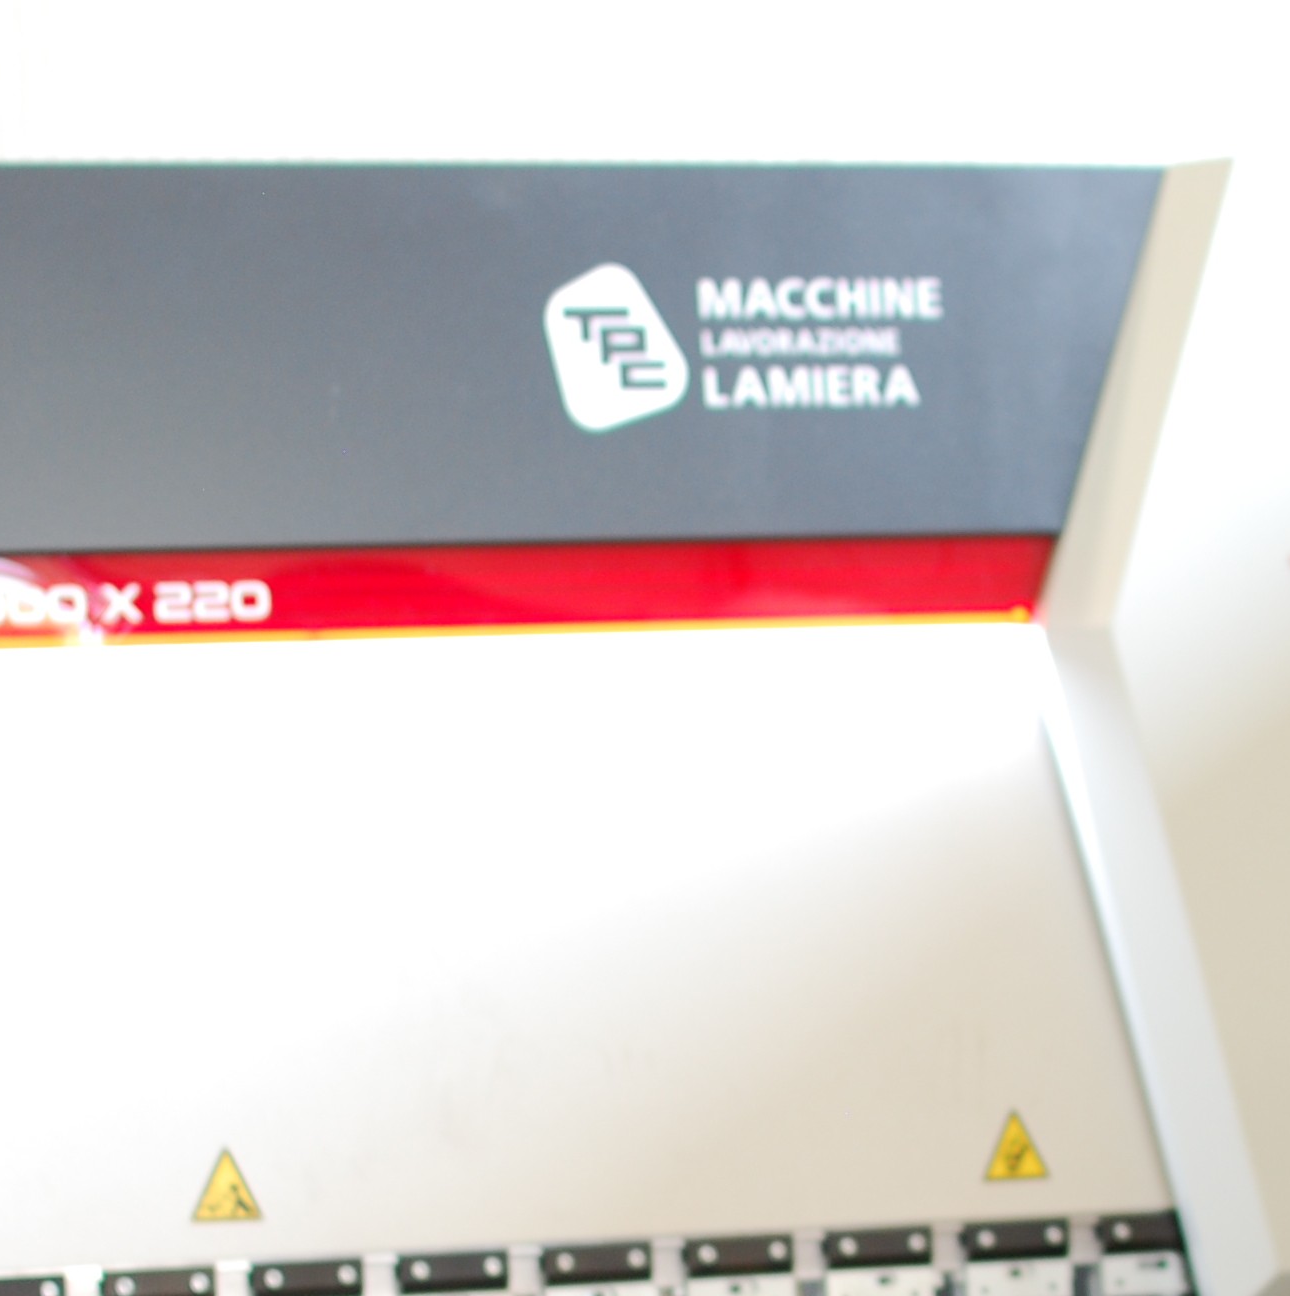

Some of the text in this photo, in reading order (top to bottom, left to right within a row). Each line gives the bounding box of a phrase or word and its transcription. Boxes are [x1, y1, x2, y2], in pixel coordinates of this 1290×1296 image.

[696, 277, 944, 319] MACCHINE
[563, 306, 667, 389] TPC
[699, 327, 901, 357] LAVORAZIONE
[703, 364, 920, 408] LAMIERA
[153, 579, 273, 623] 220
